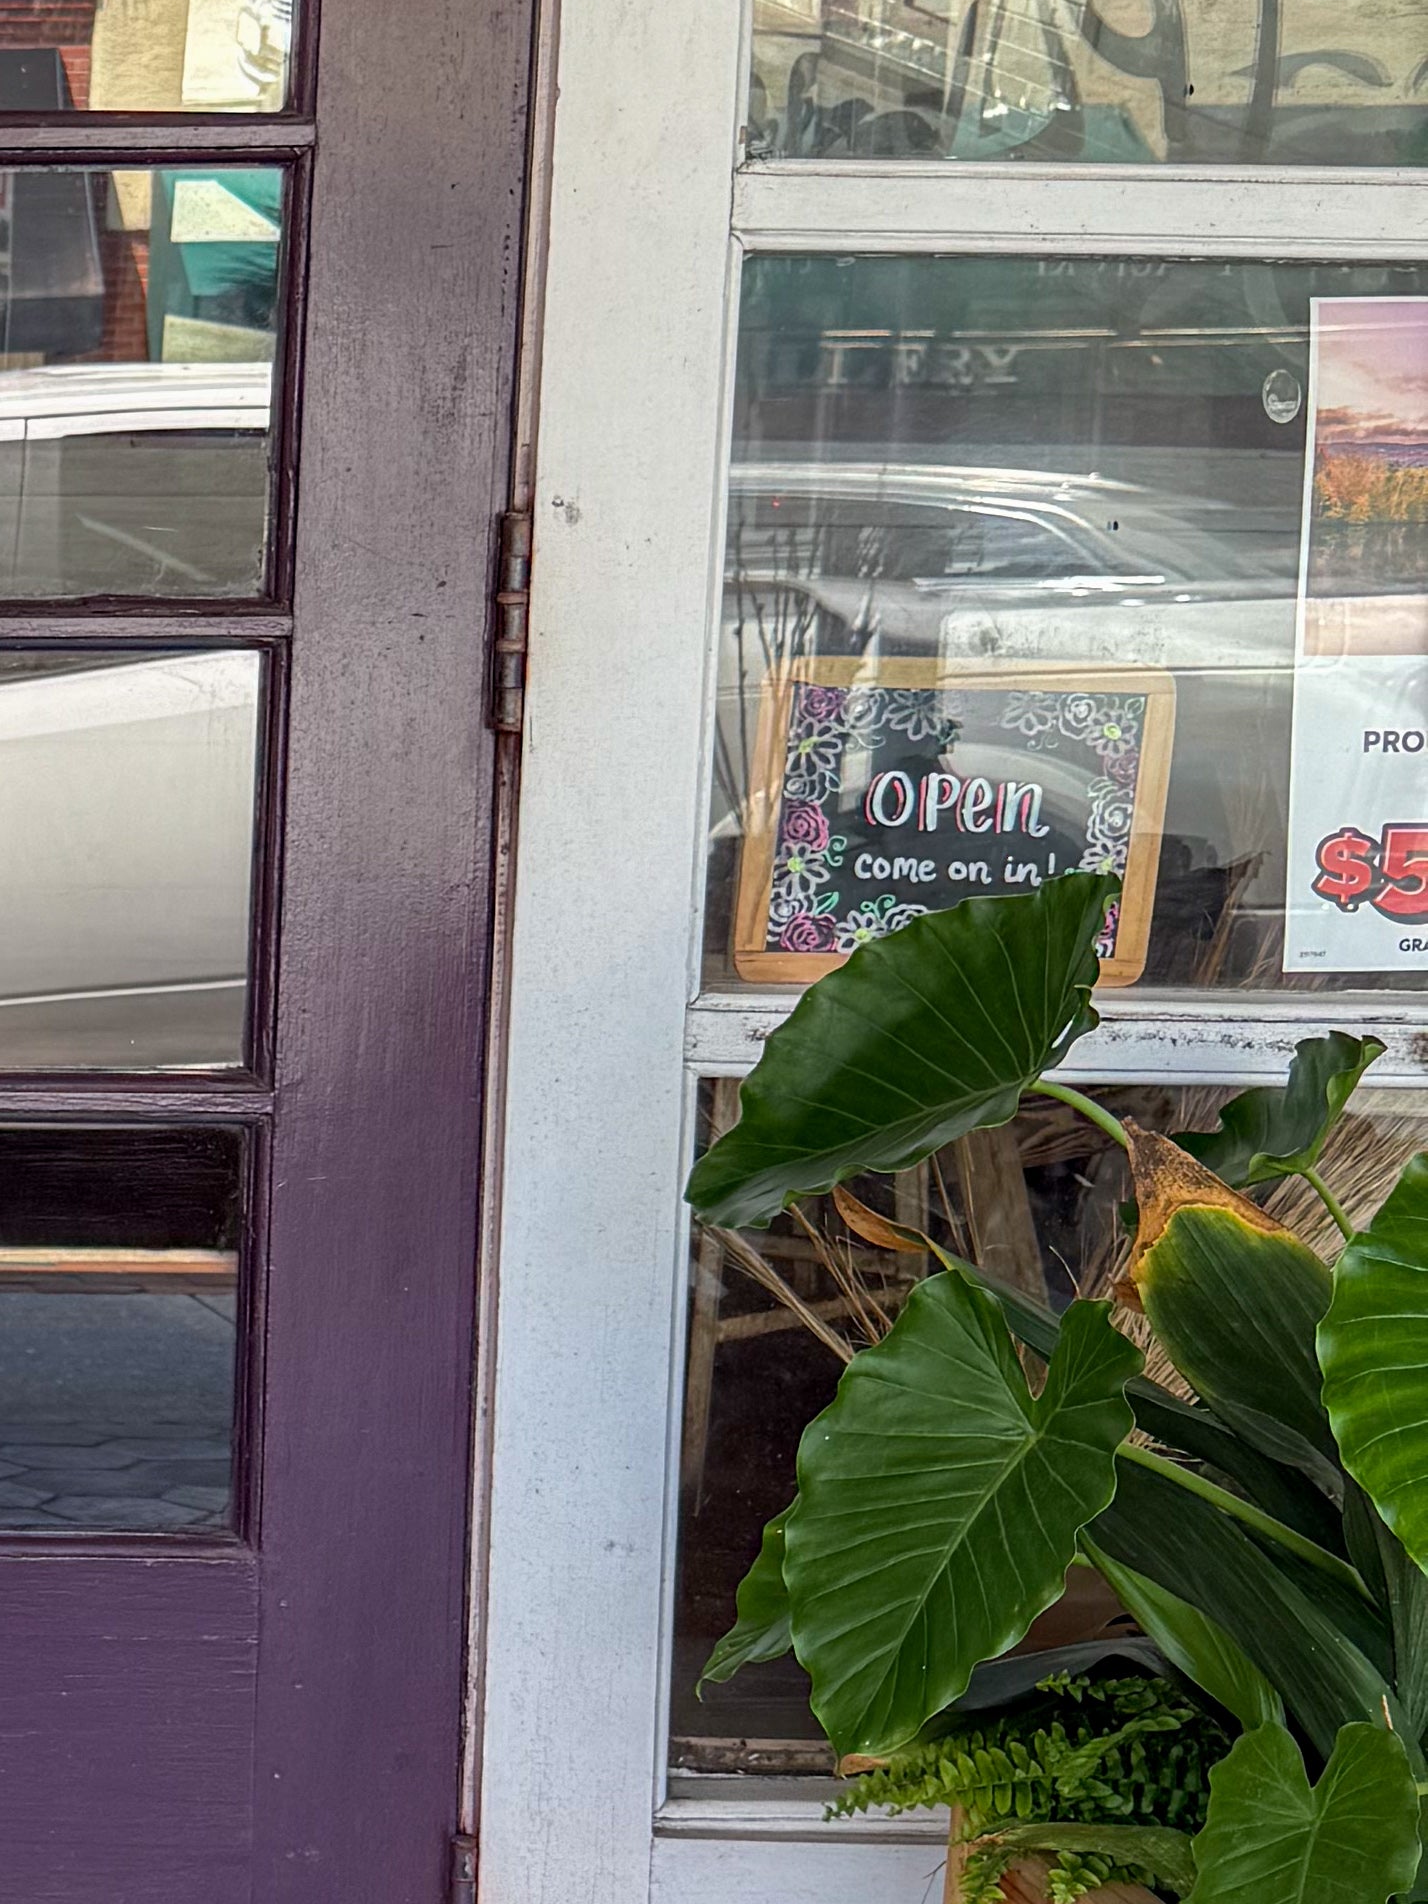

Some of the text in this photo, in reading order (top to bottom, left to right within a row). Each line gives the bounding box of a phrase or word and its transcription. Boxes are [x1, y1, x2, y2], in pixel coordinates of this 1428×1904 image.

[854, 852, 1055, 885] come on in!
